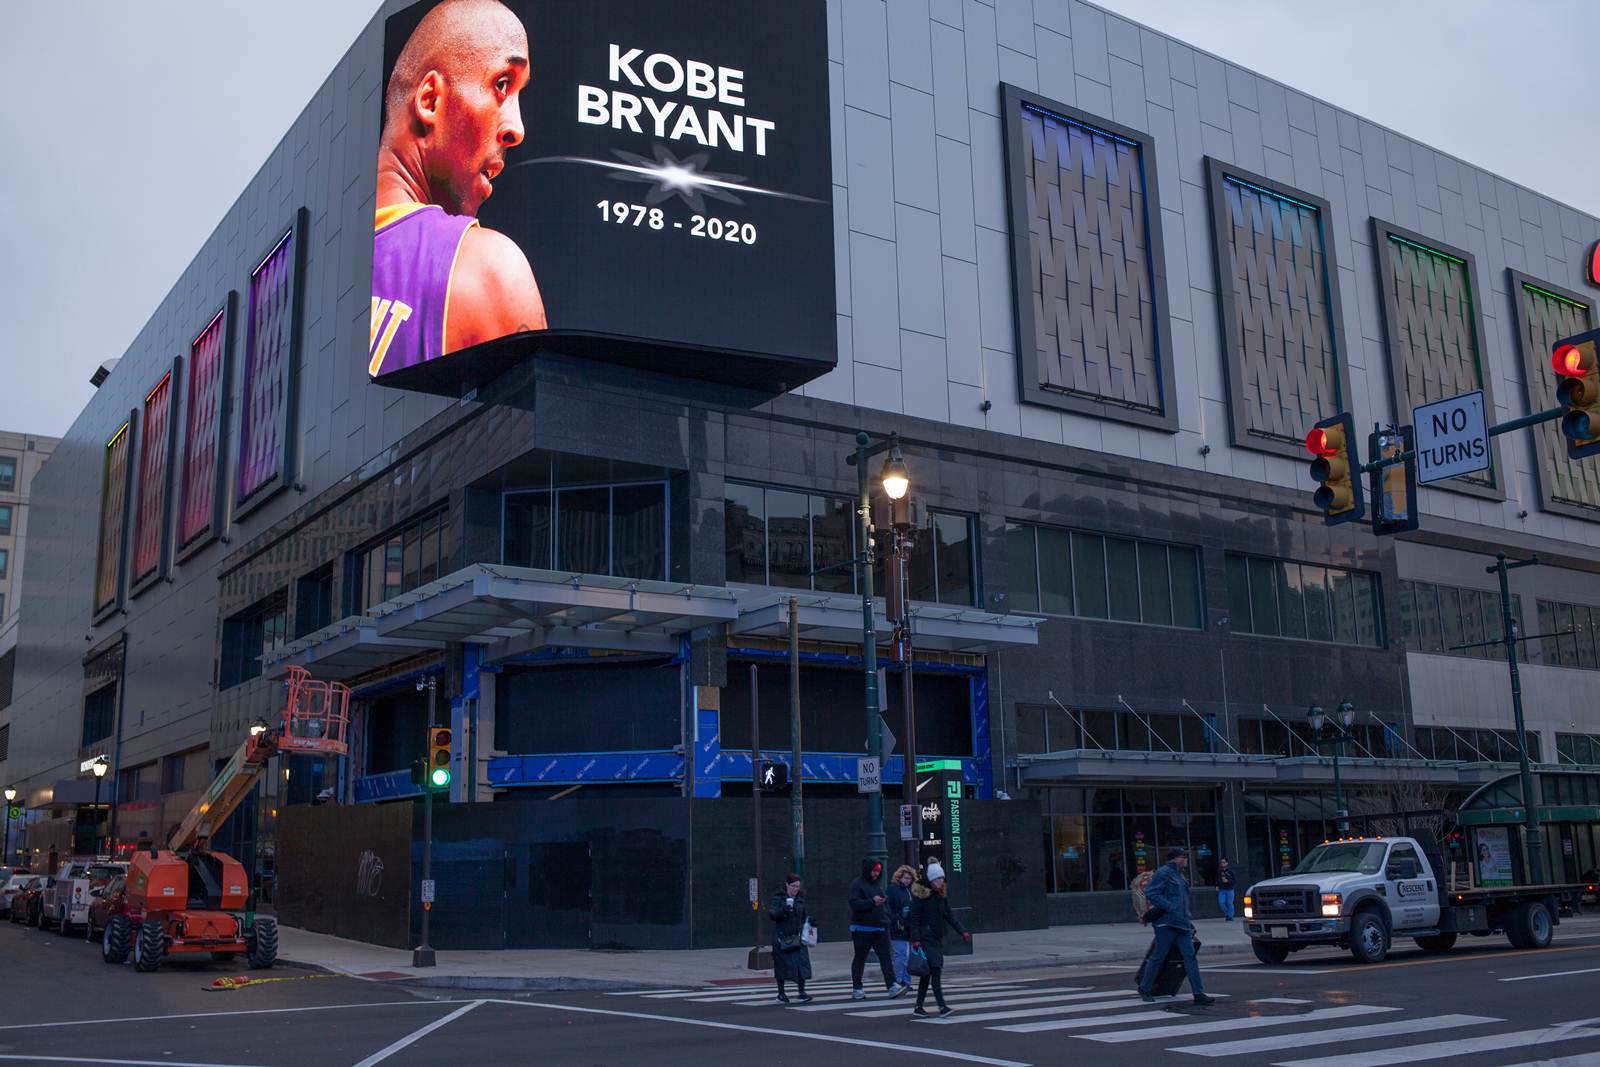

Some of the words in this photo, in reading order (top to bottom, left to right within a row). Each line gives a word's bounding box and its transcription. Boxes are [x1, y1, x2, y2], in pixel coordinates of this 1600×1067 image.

[608, 43, 746, 107] KOBE
[577, 84, 775, 156] BRYANT
[596, 199, 665, 230] 1978
[690, 214, 757, 245] 2020
[1432, 407, 1467, 438] NO
[1420, 437, 1485, 469] TURNS
[860, 776, 878, 787] TURNS
[863, 762, 875, 774] NO
[950, 799, 960, 834] FASHION
[952, 836, 961, 873] DISTRICT
